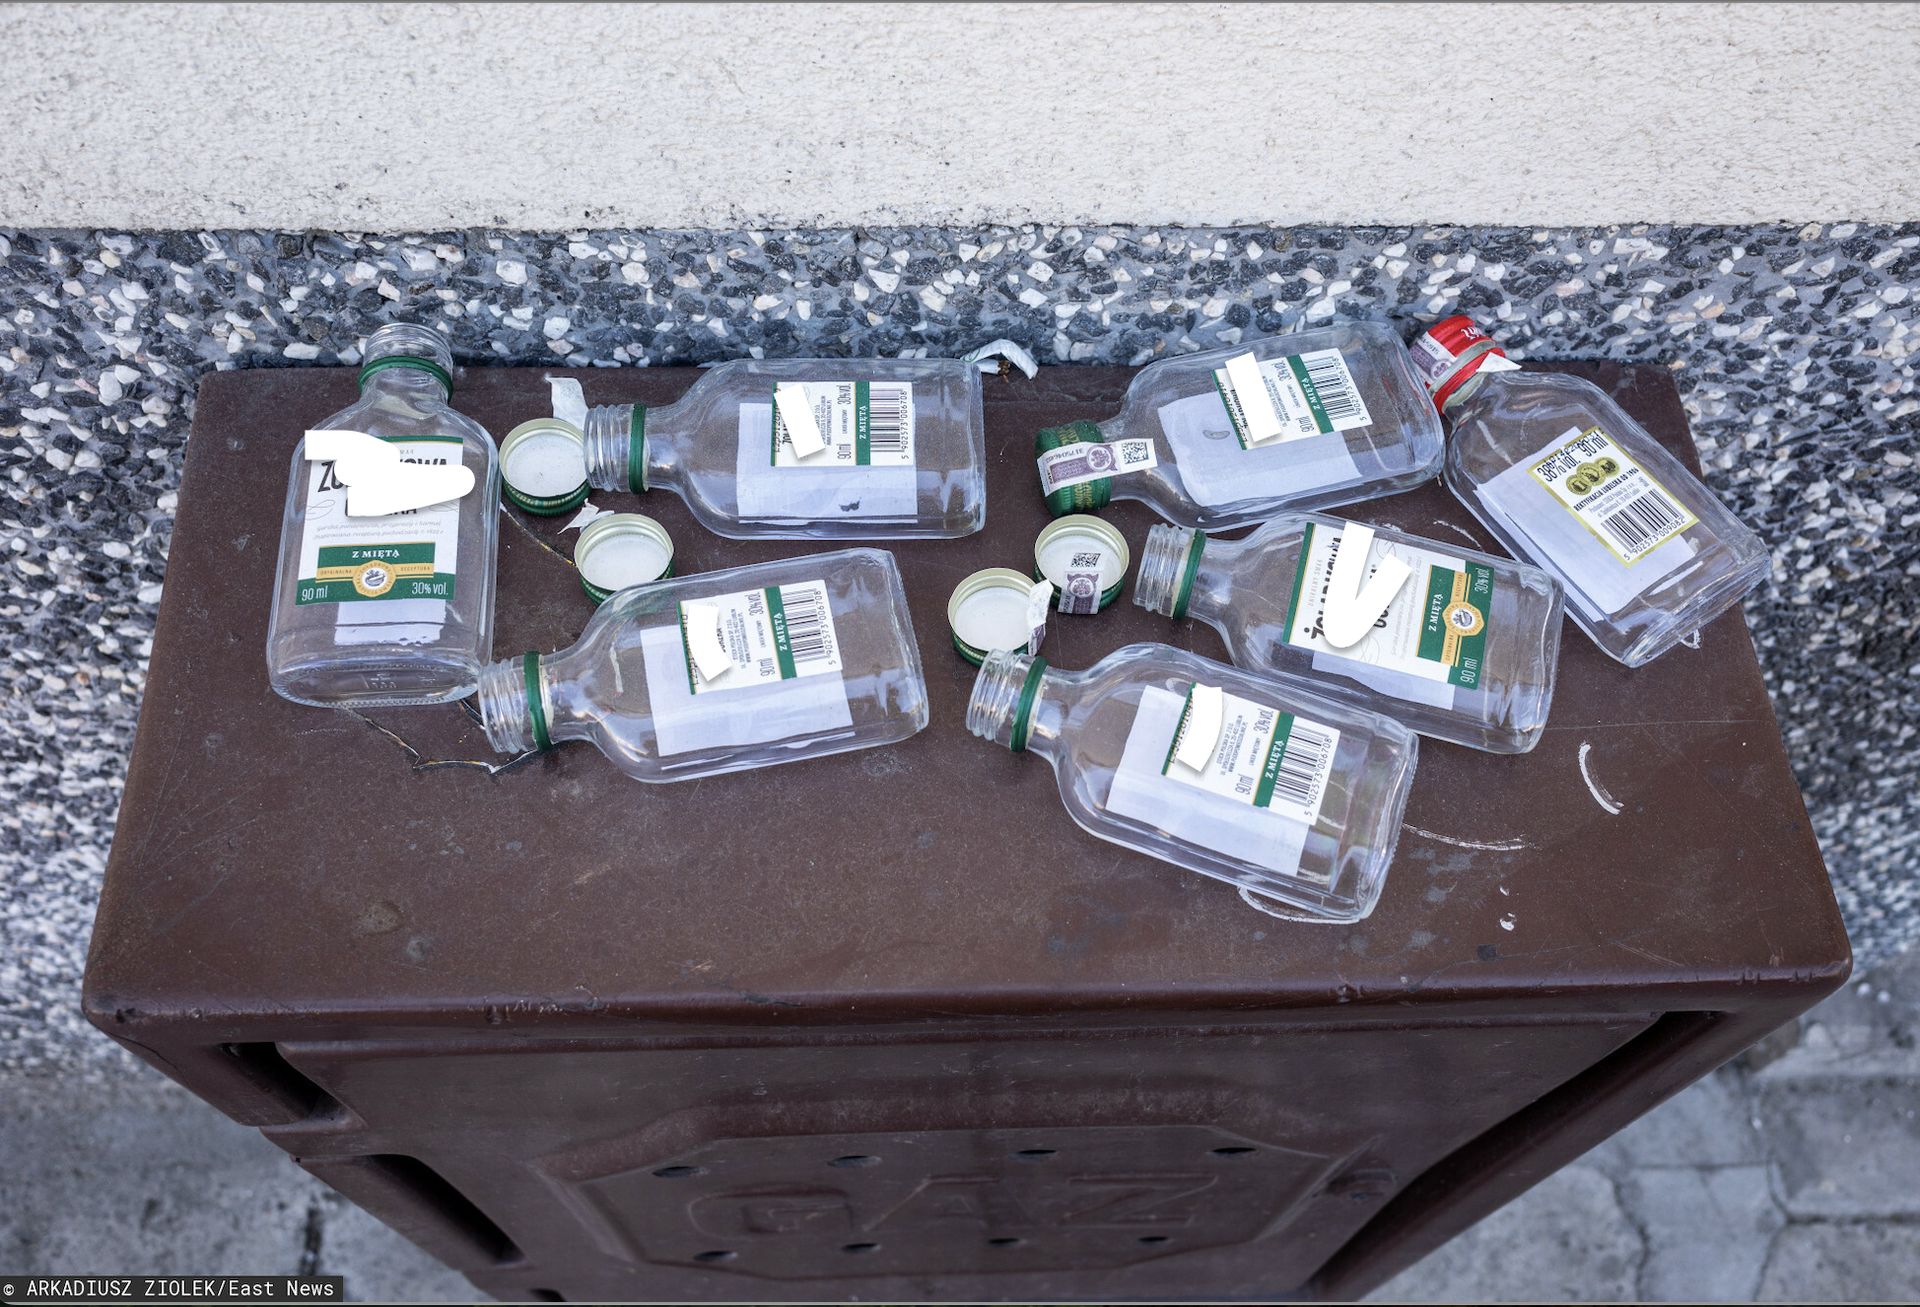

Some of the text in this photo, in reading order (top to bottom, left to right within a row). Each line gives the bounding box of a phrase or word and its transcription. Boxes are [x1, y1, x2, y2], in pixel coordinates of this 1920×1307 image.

[1334, 358, 1349, 383] 006708
[837, 393, 851, 404] 30%
[1301, 378, 1317, 403] MIĘTĄ
[1345, 386, 1361, 411] 902573
[899, 390, 907, 418] 006708
[859, 405, 867, 432] MIĘTĄ
[1295, 415, 1311, 424] ml
[1300, 423, 1314, 432] 90
[900, 422, 908, 449] 902573
[837, 451, 851, 459] 90
[1574, 492, 1602, 511] REKTYFIKACJA
[1601, 477, 1622, 493] LUBELSKA
[1626, 467, 1639, 476] 1906
[1632, 536, 1658, 554] 902573
[1659, 518, 1685, 536] 009082
[362, 549, 399, 558] MIĘTĄ
[301, 581, 448, 601] 90 ml 30% vol.
[1473, 578, 1489, 593] 30%
[747, 601, 763, 616] 30%
[815, 590, 826, 621] 006708
[1429, 593, 1443, 624] MIĘTĄ
[774, 613, 788, 651] Z MIĘTĄ
[821, 624, 832, 655] 902573
[756, 657, 773, 667] ml
[759, 665, 775, 677] 90
[1463, 657, 1477, 669] ml
[1460, 669, 1476, 683] 90
[1253, 719, 1270, 733] 30%
[1264, 740, 1284, 779] Z MIĘTĄ
[1238, 773, 1253, 785] ml
[1307, 773, 1322, 805] 902573
[1317, 737, 1332, 769] 006708
[1234, 782, 1251, 794] 90
[686, 1173, 1219, 1234] GAZ
